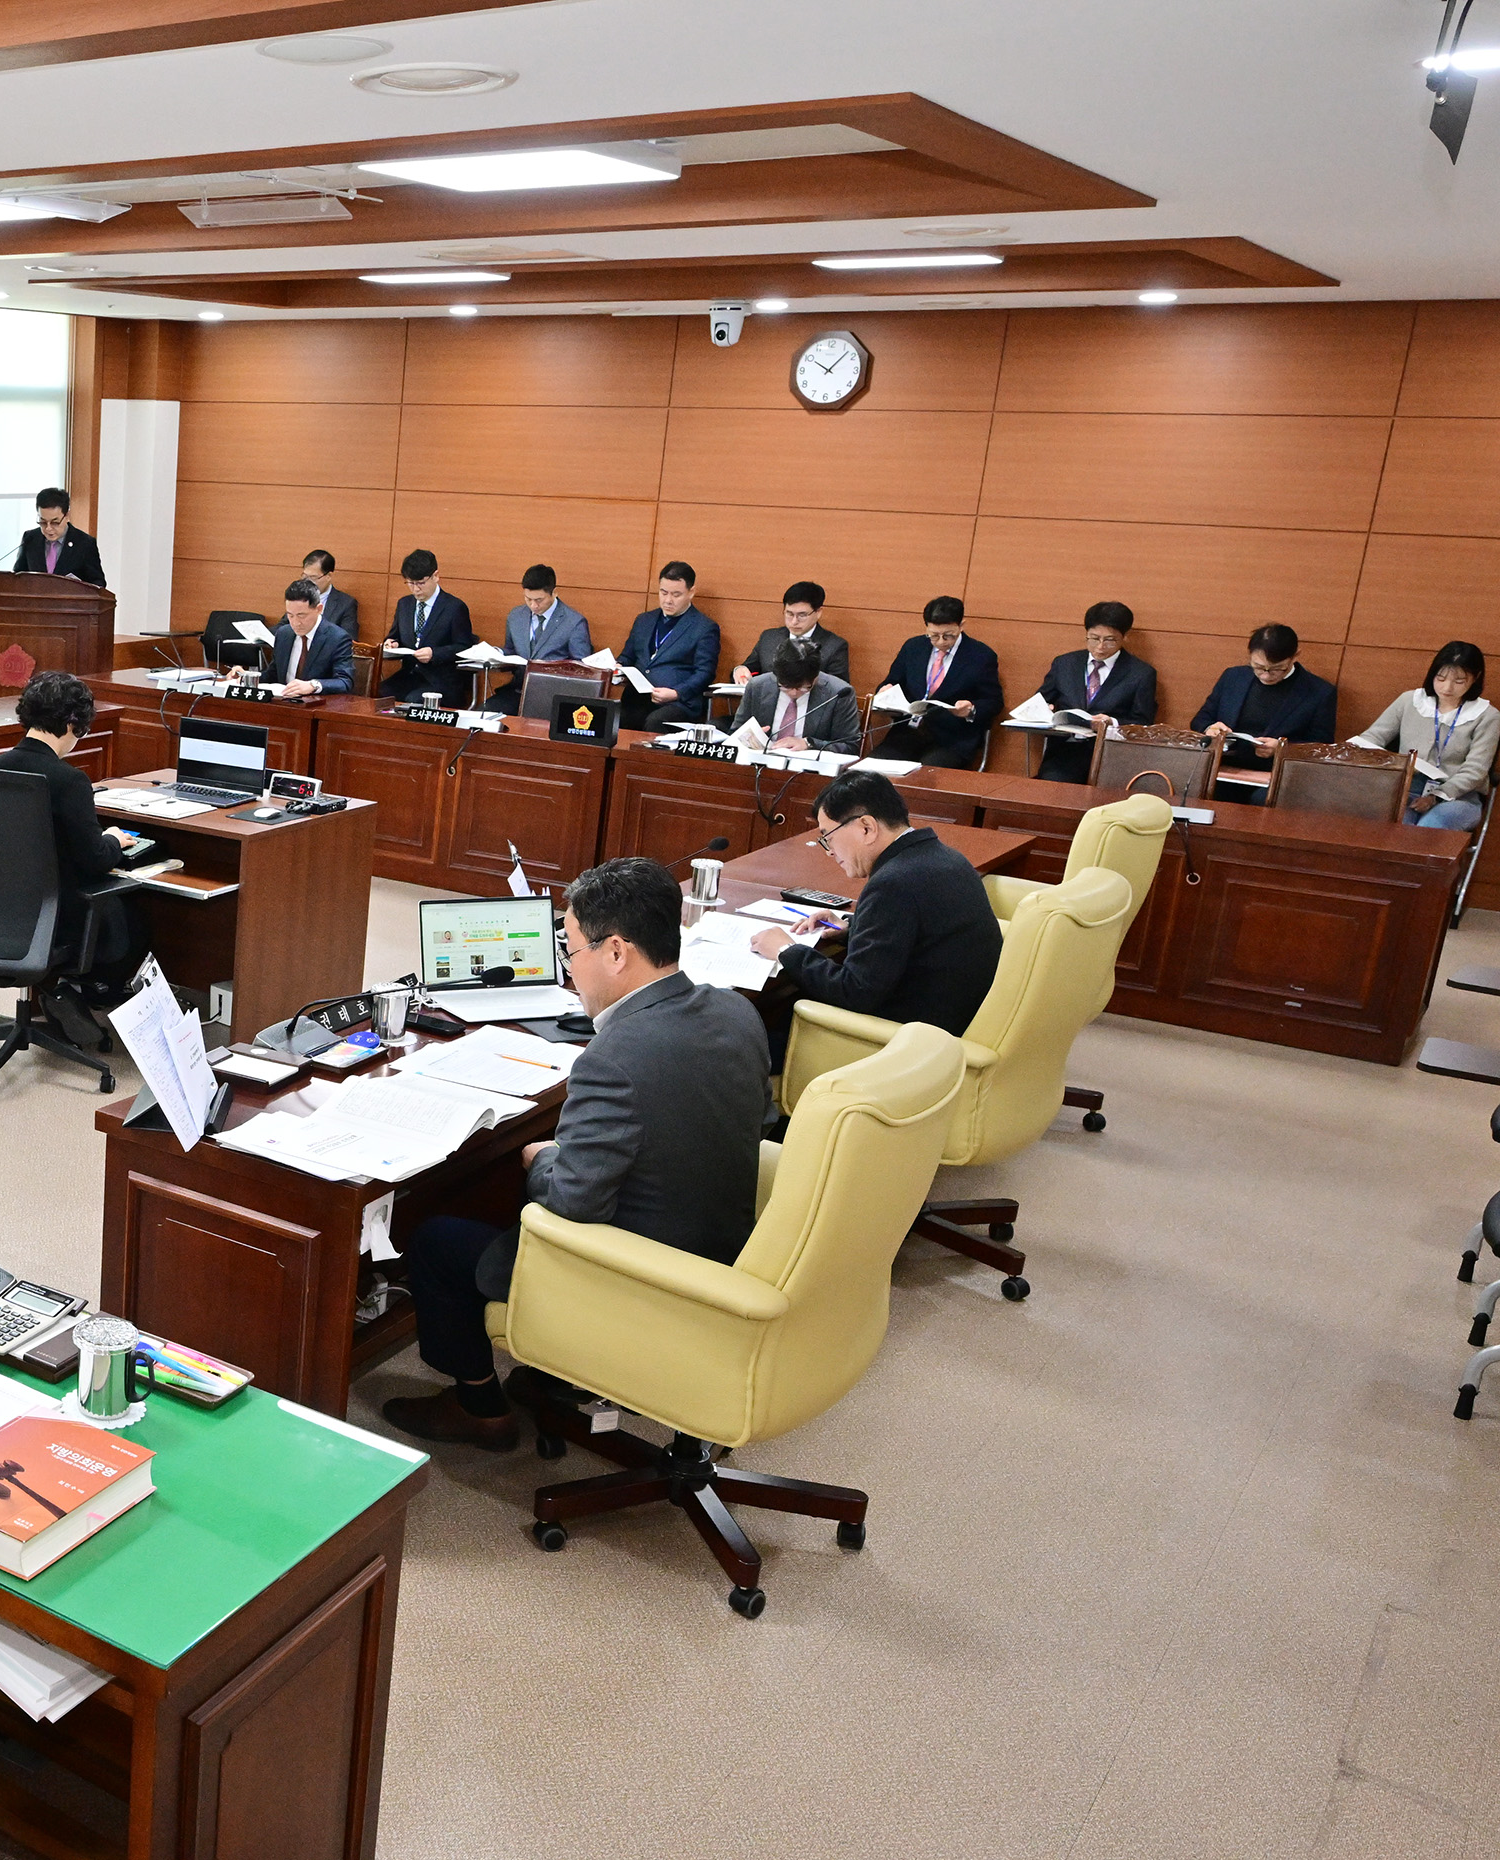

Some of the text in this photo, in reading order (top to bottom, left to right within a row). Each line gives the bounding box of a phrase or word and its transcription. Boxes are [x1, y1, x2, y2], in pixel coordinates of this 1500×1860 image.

[828, 340, 836, 348] 12
[805, 354, 814, 362] 10
[850, 353, 856, 361] 2
[800, 367, 805, 375] 9
[853, 366, 858, 374] 3
[802, 380, 808, 388] 8
[846, 380, 852, 388] 4
[823, 393, 828, 401] 6
[836, 390, 841, 398] 5
[231, 687, 266, 701] 본부장
[409, 708, 455, 724] 도시공사사장
[678, 741, 736, 760] 기획감사실장
[319, 1000, 369, 1030] 권태호
[45, 1442, 119, 1478] 지방의회운영
